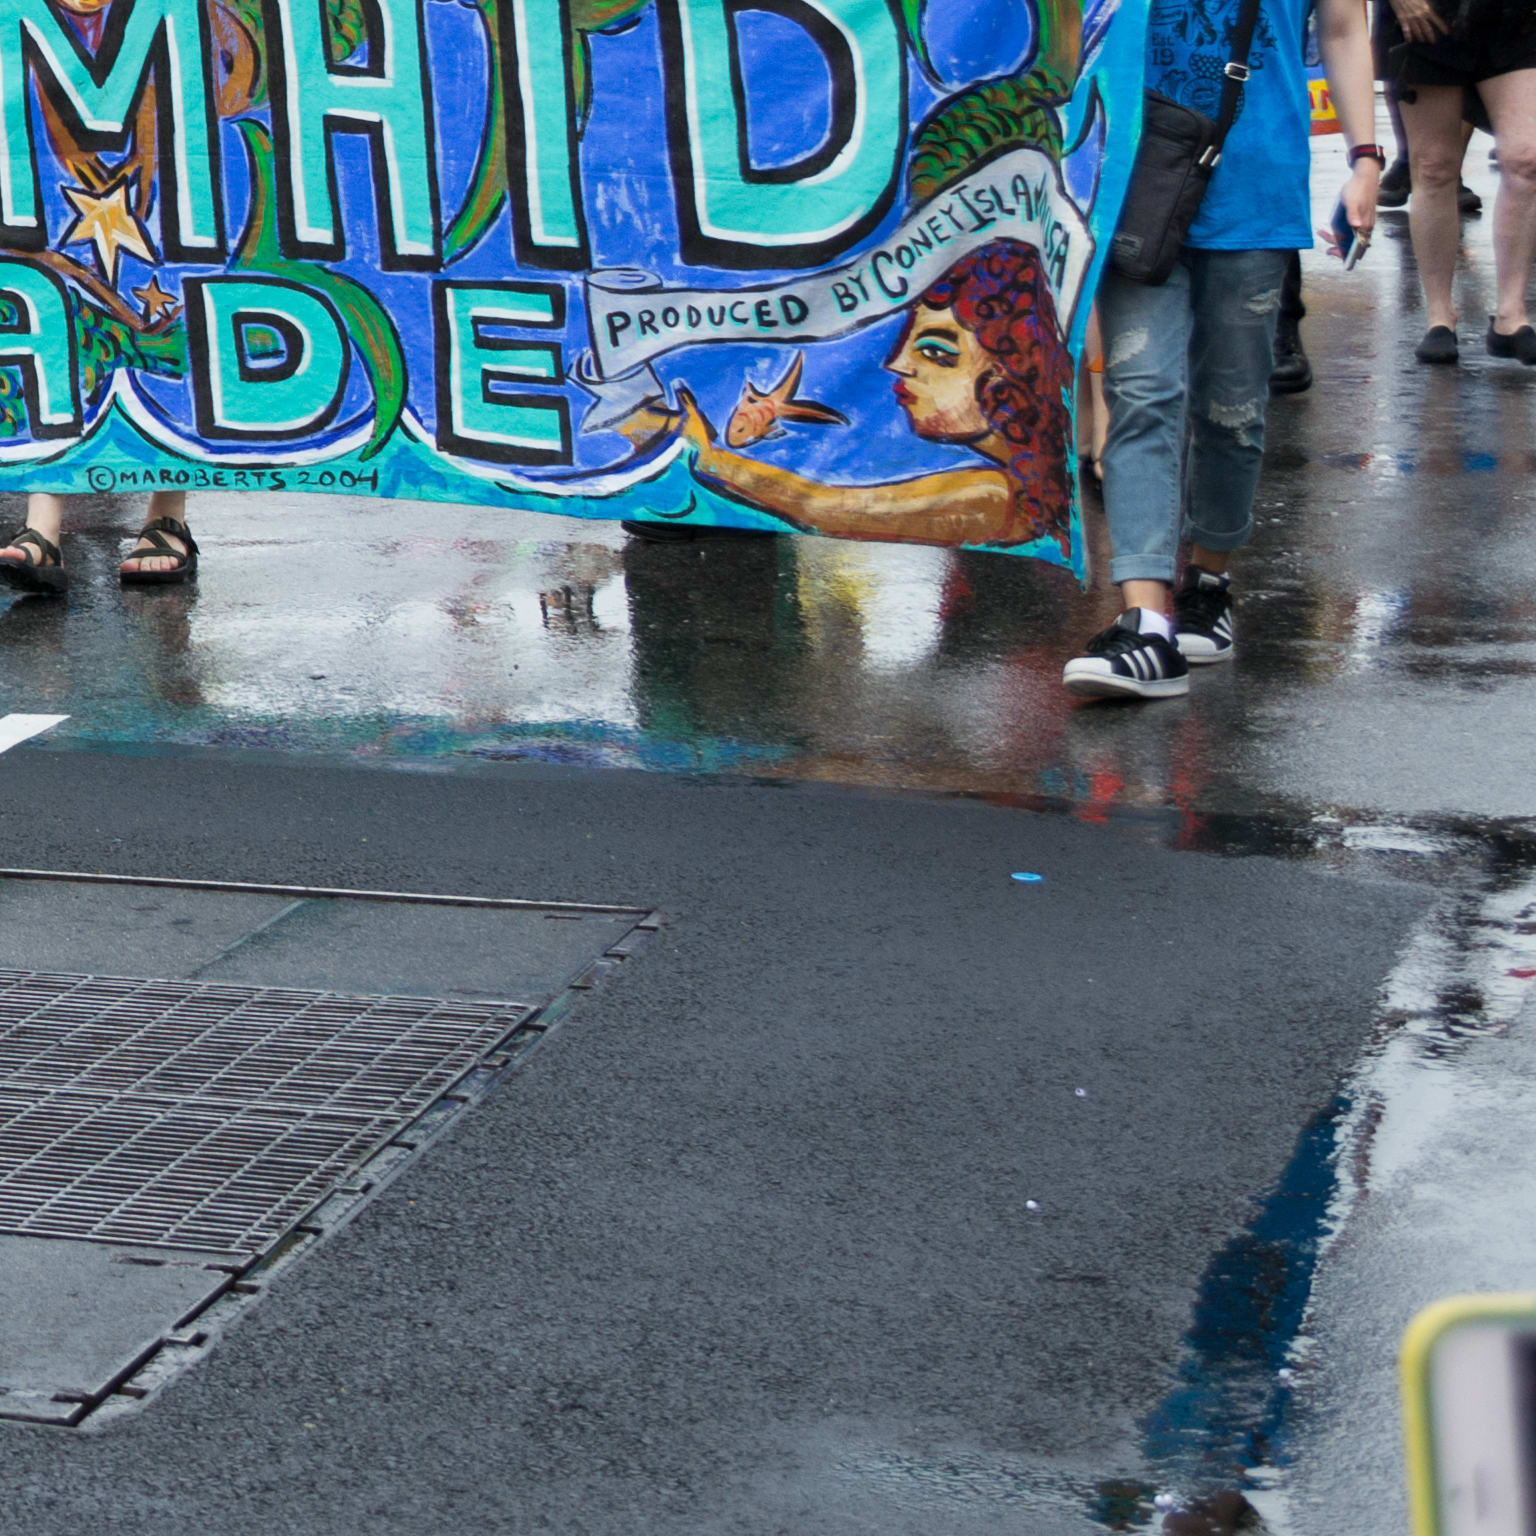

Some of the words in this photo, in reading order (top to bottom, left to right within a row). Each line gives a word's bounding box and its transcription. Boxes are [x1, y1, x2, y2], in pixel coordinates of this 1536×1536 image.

[606, 291, 809, 349] PRODUCED
[831, 272, 876, 314] BY
[869, 203, 964, 301] CONEY
[296, 467, 380, 492] 2004
